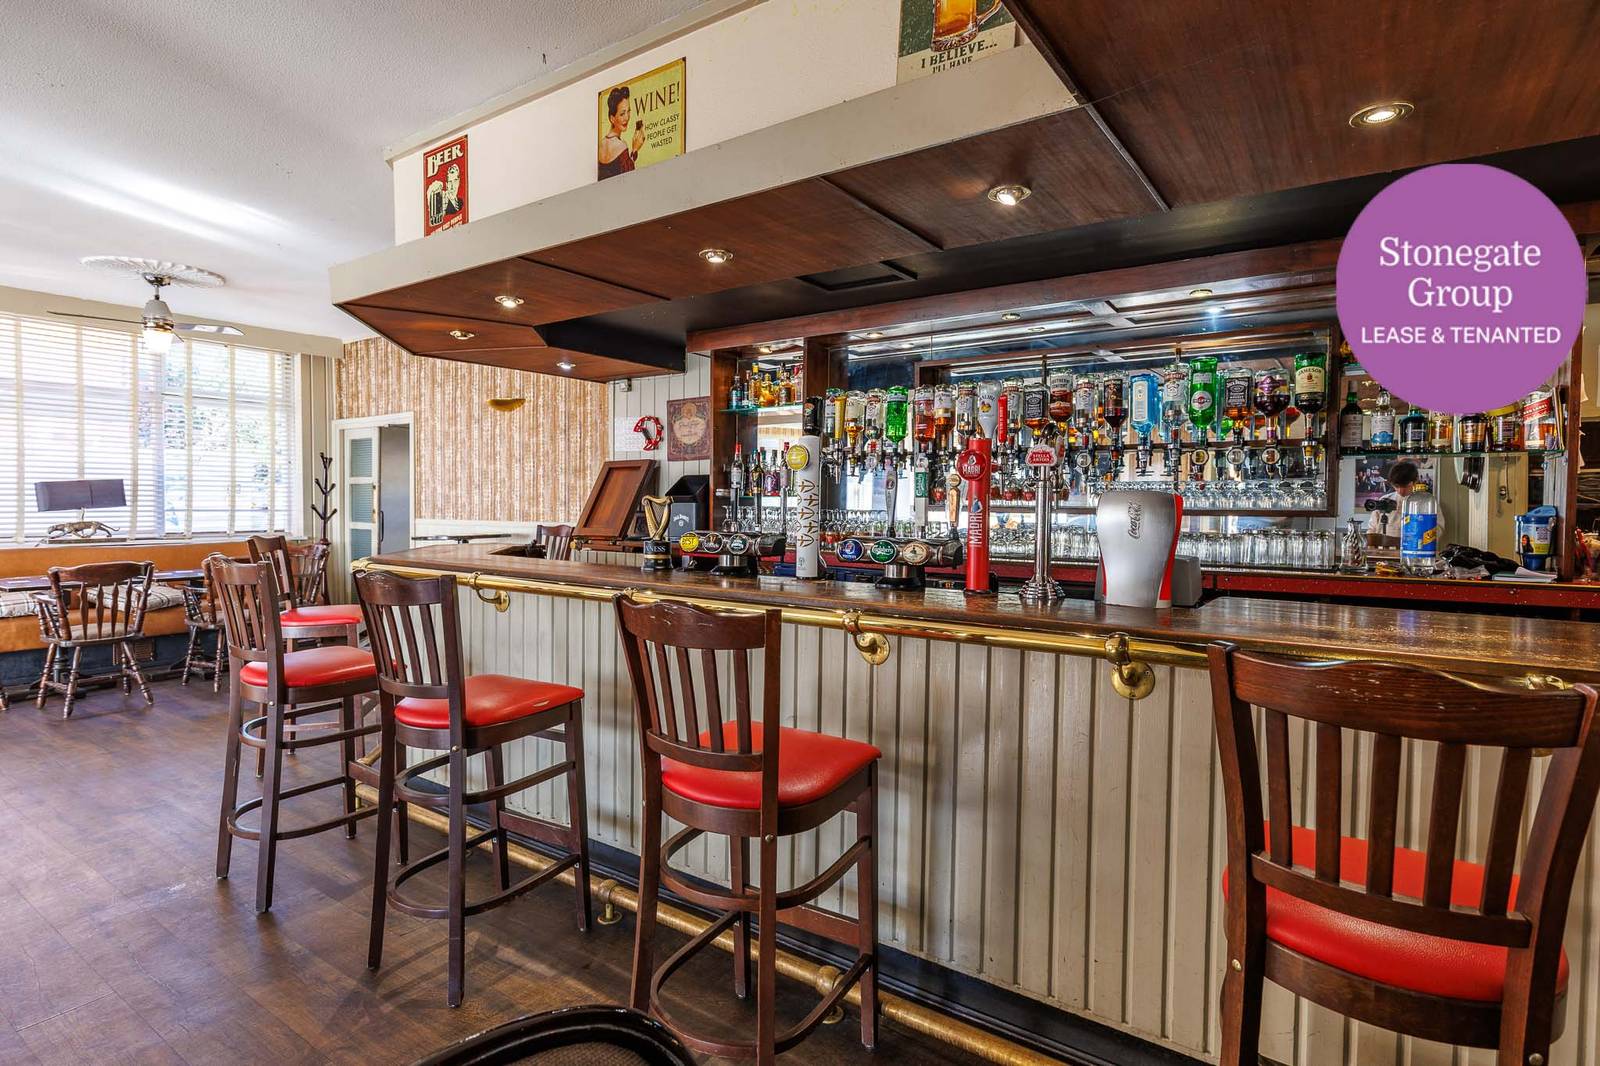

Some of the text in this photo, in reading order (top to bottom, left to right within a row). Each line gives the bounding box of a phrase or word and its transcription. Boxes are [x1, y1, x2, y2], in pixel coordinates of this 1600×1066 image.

[634, 81, 680, 117] WINE!
[644, 112, 680, 131] HOW CLASSY
[647, 124, 677, 140] PEOPLE GET
[650, 136, 673, 149] WASTED
[427, 144, 464, 178] BEER
[1297, 367, 1322, 376] JAMESON
